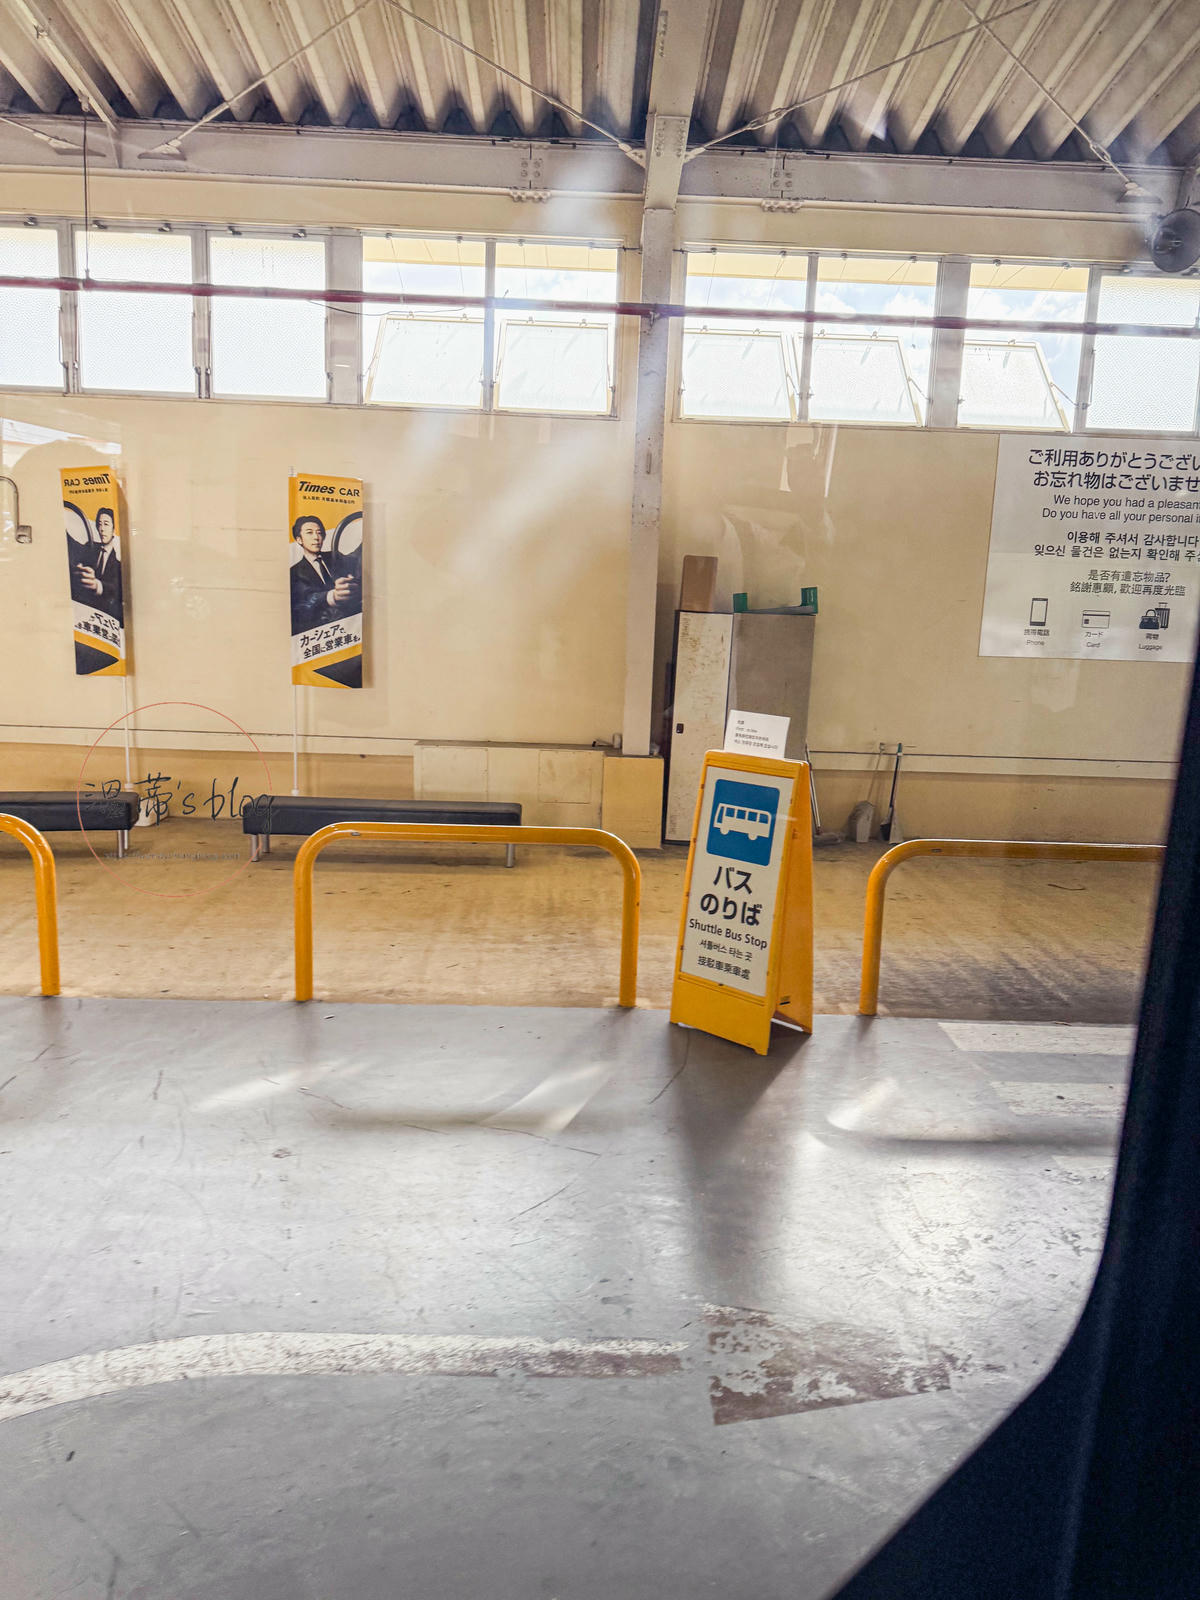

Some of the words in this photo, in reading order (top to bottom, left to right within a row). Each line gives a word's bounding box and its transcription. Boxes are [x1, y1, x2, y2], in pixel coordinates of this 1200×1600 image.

[298, 481, 335, 494] Times
[339, 488, 360, 497] CAR
[1054, 494, 1070, 505] We
[1074, 496, 1100, 508] hope
[1103, 498, 1121, 509] you
[1125, 497, 1145, 508] had
[1042, 508, 1057, 518] Do
[1060, 509, 1078, 520] you
[1082, 509, 1106, 520] have
[1109, 510, 1120, 520] all
[1123, 512, 1146, 523] your
[1148, 513, 1193, 524] personal
[1067, 531, 1100, 543] 이용해
[1105, 532, 1138, 545] 주셔서
[1143, 534, 1199, 547] 감사합니다
[1034, 544, 1066, 557] 잊으신
[1071, 545, 1104, 558] 물건은
[1109, 546, 1141, 560] 없는지
[1146, 548, 1180, 561] 확인해
[1138, 643, 1163, 651] Luggage
[713, 866, 752, 894] バス
[700, 893, 762, 926] のりば
[689, 918, 722, 936] Shuttle
[725, 928, 742, 942] Bus
[745, 933, 768, 950] Stop
[699, 939, 728, 954] 셔틀버스
[729, 948, 744, 959] 타는
[745, 952, 753, 962] 곳
